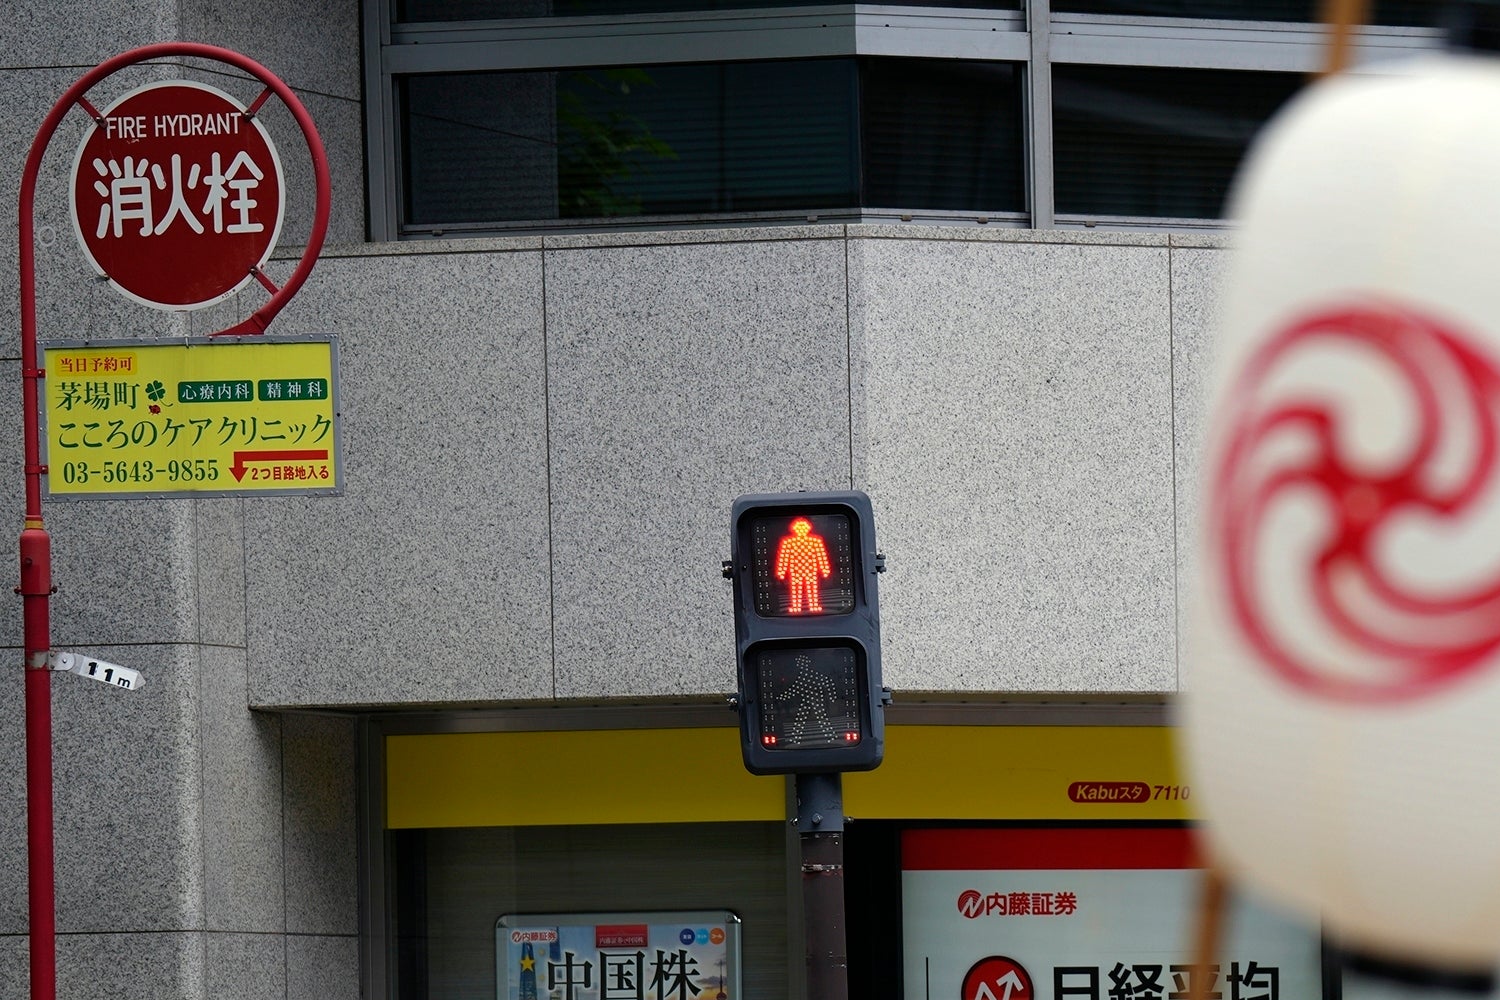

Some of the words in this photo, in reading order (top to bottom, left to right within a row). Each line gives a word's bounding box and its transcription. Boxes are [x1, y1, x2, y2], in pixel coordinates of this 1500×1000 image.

[106, 116, 147, 139] FIRE
[154, 112, 241, 138] HYDRANT
[93, 150, 265, 239] 消火栓
[60, 356, 133, 373] 当日予約可
[55, 381, 140, 411] 茅場町
[182, 384, 251, 400] 心療内科
[266, 381, 323, 398] 精神科
[58, 414, 332, 449] こころのケアクリニック
[63, 459, 219, 483] 03-5643-9855
[251, 465, 330, 481] 2つ目路地入る
[1075, 784, 1143, 801] Kabuスタ
[1153, 785, 1191, 800] 7110
[985, 892, 1077, 916] 内藤証券
